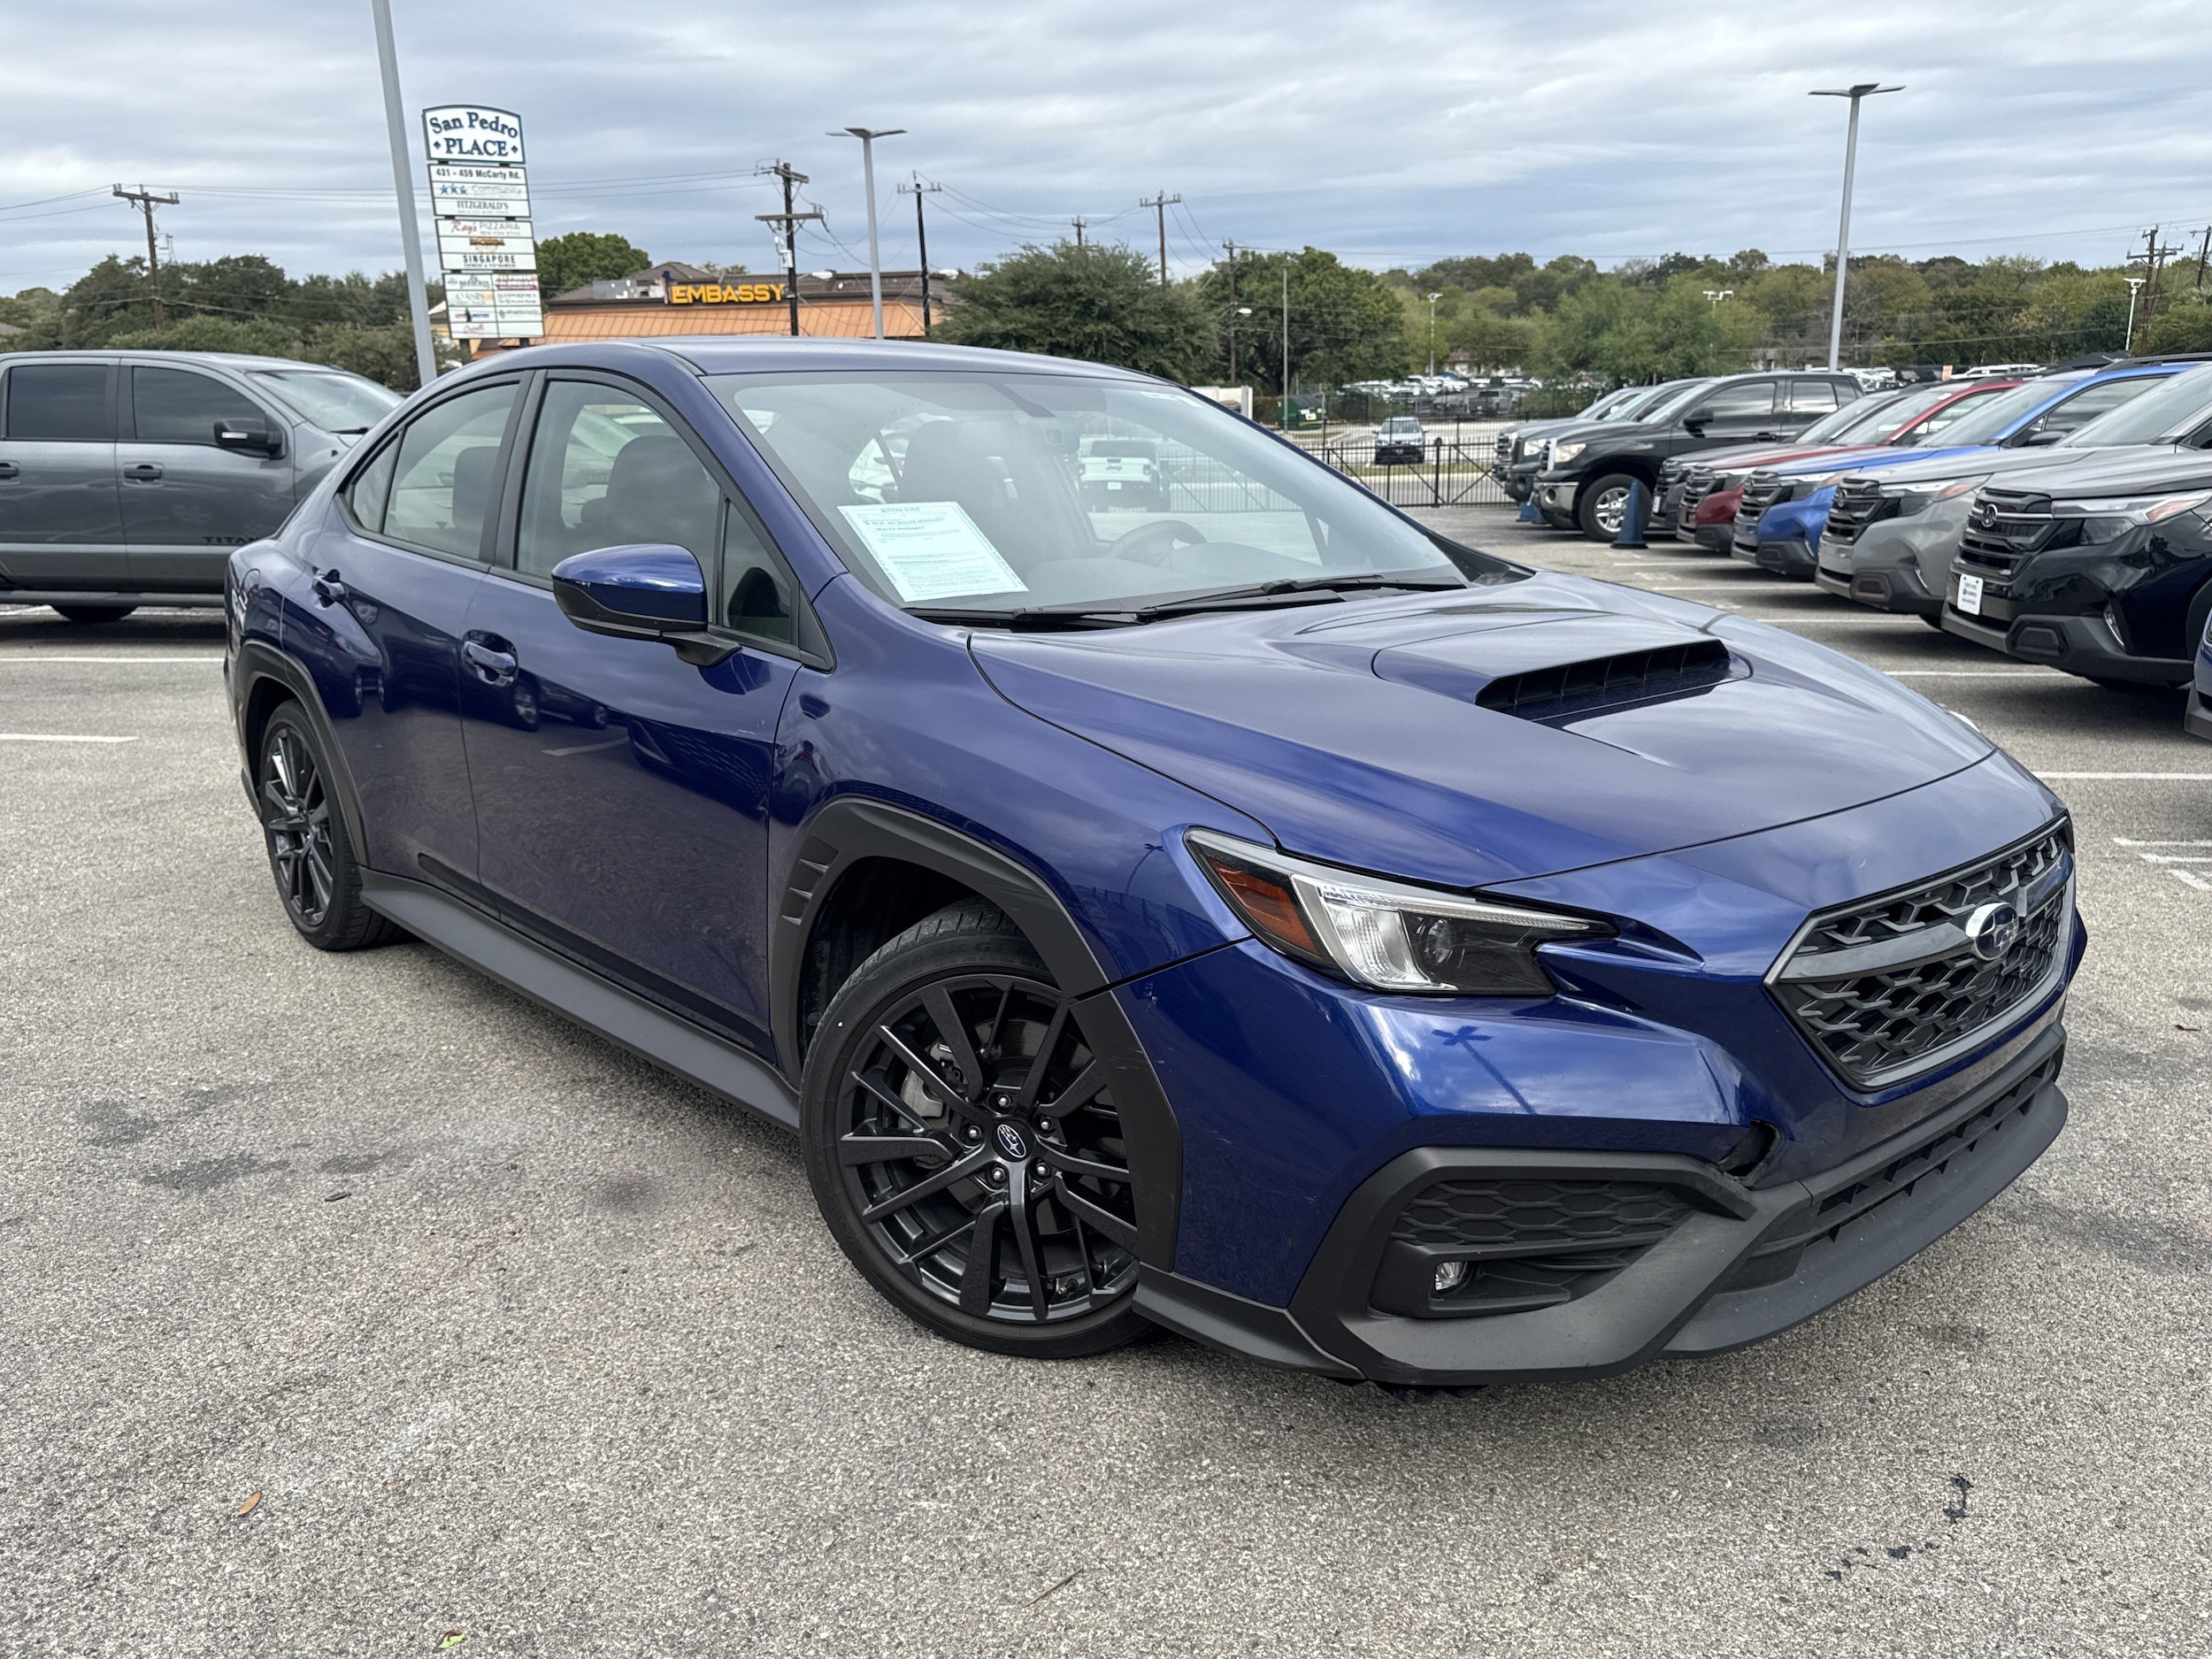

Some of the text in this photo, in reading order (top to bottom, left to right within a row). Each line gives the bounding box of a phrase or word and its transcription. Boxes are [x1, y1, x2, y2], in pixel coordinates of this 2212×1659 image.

[429, 111, 518, 139] San Pedro
[444, 137, 509, 157] PLACE
[475, 170, 507, 180] McCarty
[457, 200, 510, 211] FITZGERALD'S
[450, 219, 478, 235] Ray's
[463, 254, 516, 264] SINGAPORE
[671, 283, 786, 304] EMBASSY
